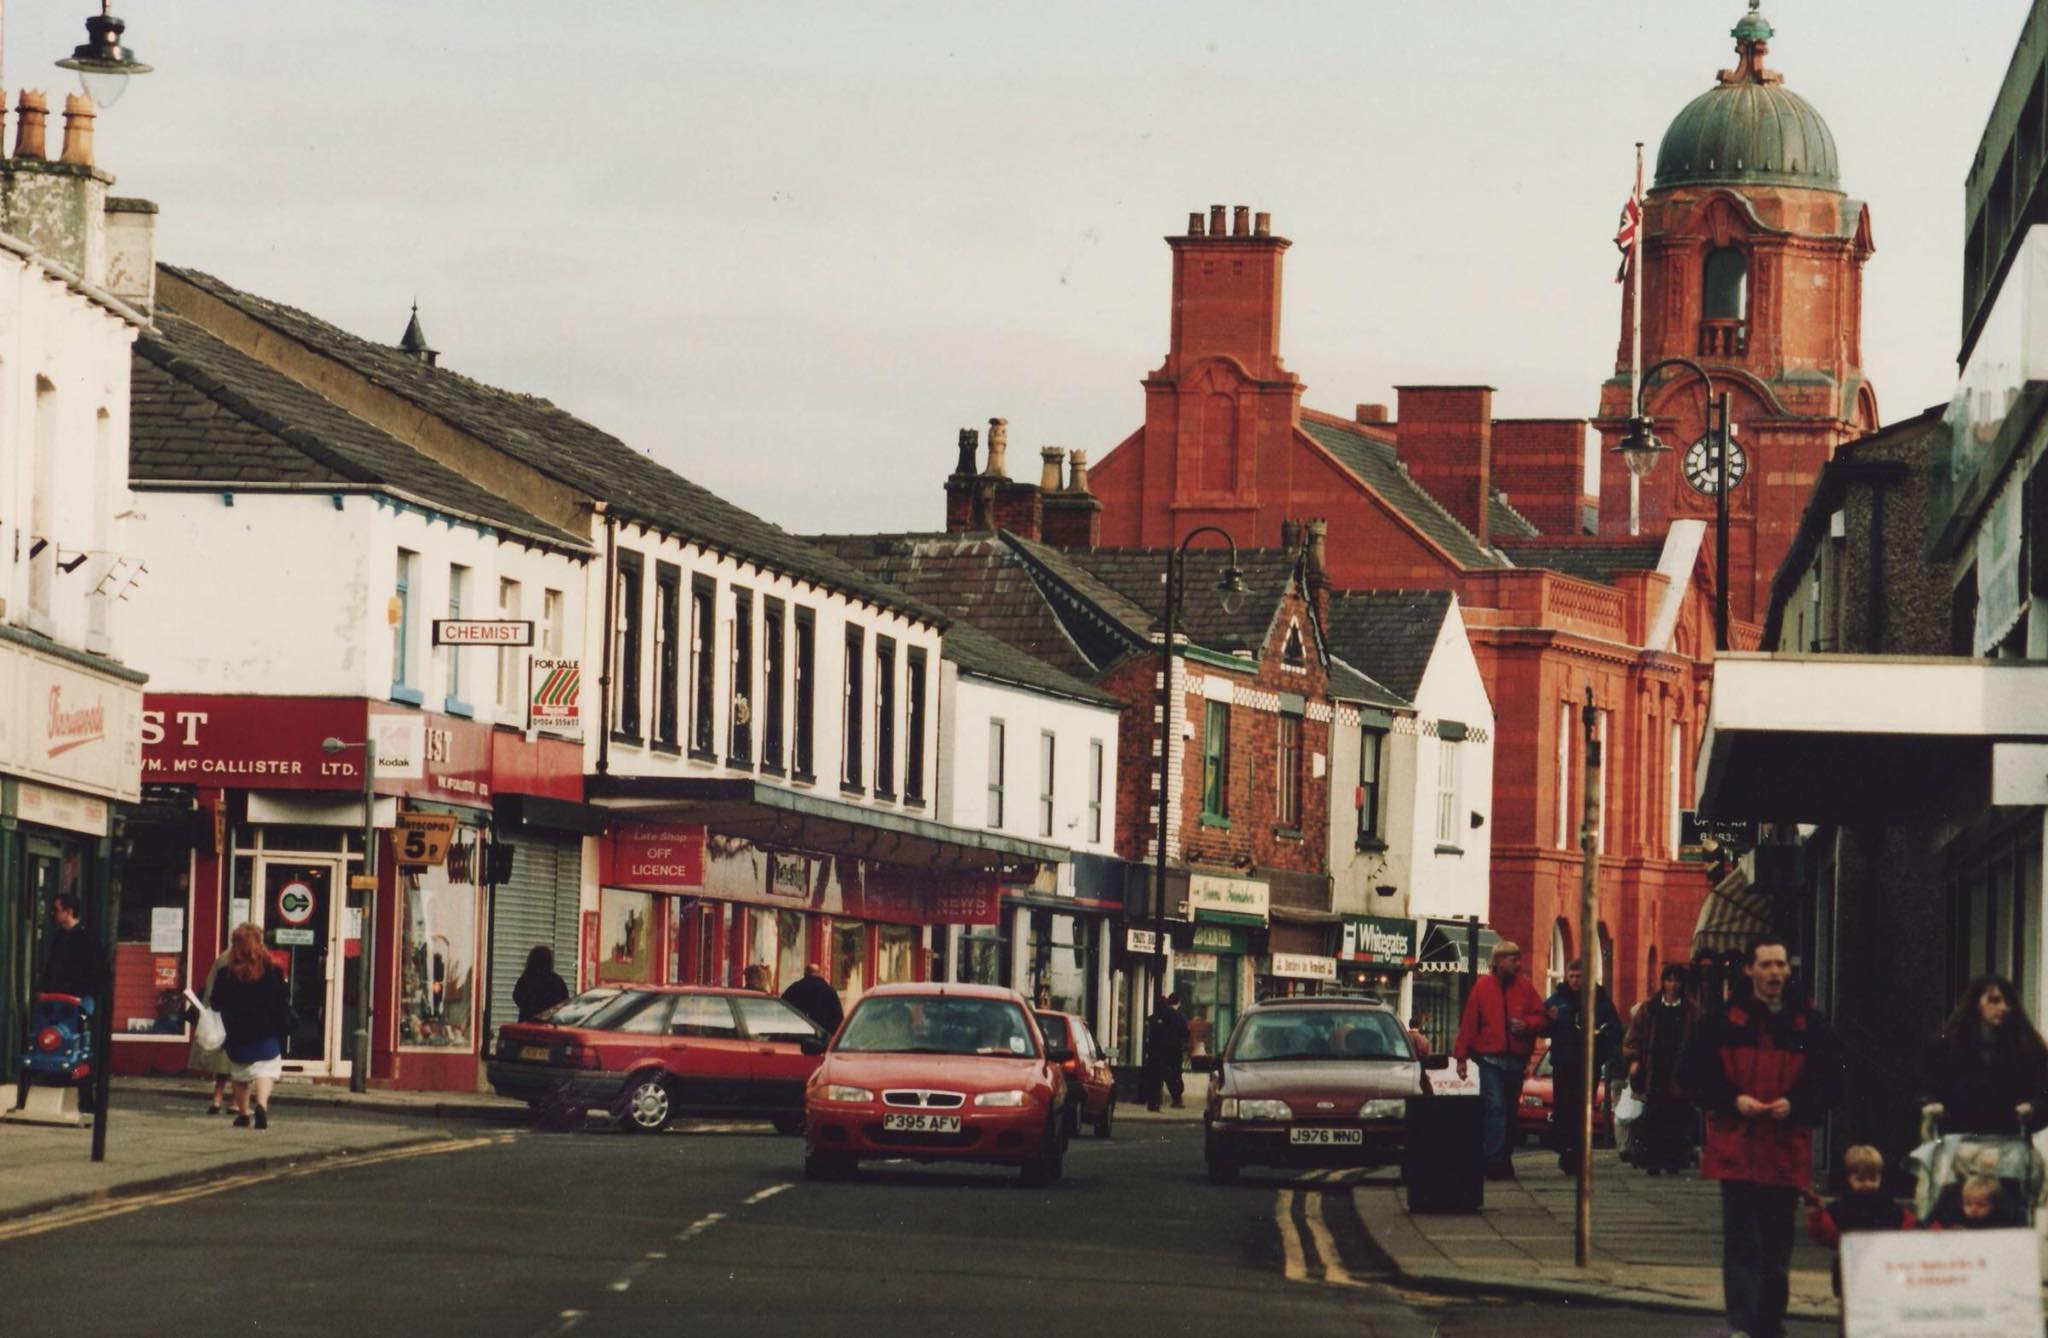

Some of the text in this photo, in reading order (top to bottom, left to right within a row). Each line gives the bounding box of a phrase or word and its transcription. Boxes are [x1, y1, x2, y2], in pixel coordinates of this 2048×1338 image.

[445, 625, 520, 640] CHEMIST
[535, 660, 579, 670] FOR SALE
[378, 758, 410, 767] Kodak
[321, 762, 358, 776] LTD.
[634, 832, 688, 844] Late Shop
[647, 848, 672, 859] OFF
[632, 864, 686, 877] LICENCE
[937, 898, 987, 910] NEWS
[1359, 922, 1409, 961] Whitegates
[885, 1114, 960, 1130] P395 AFV
[1292, 1131, 1329, 1142] J976
